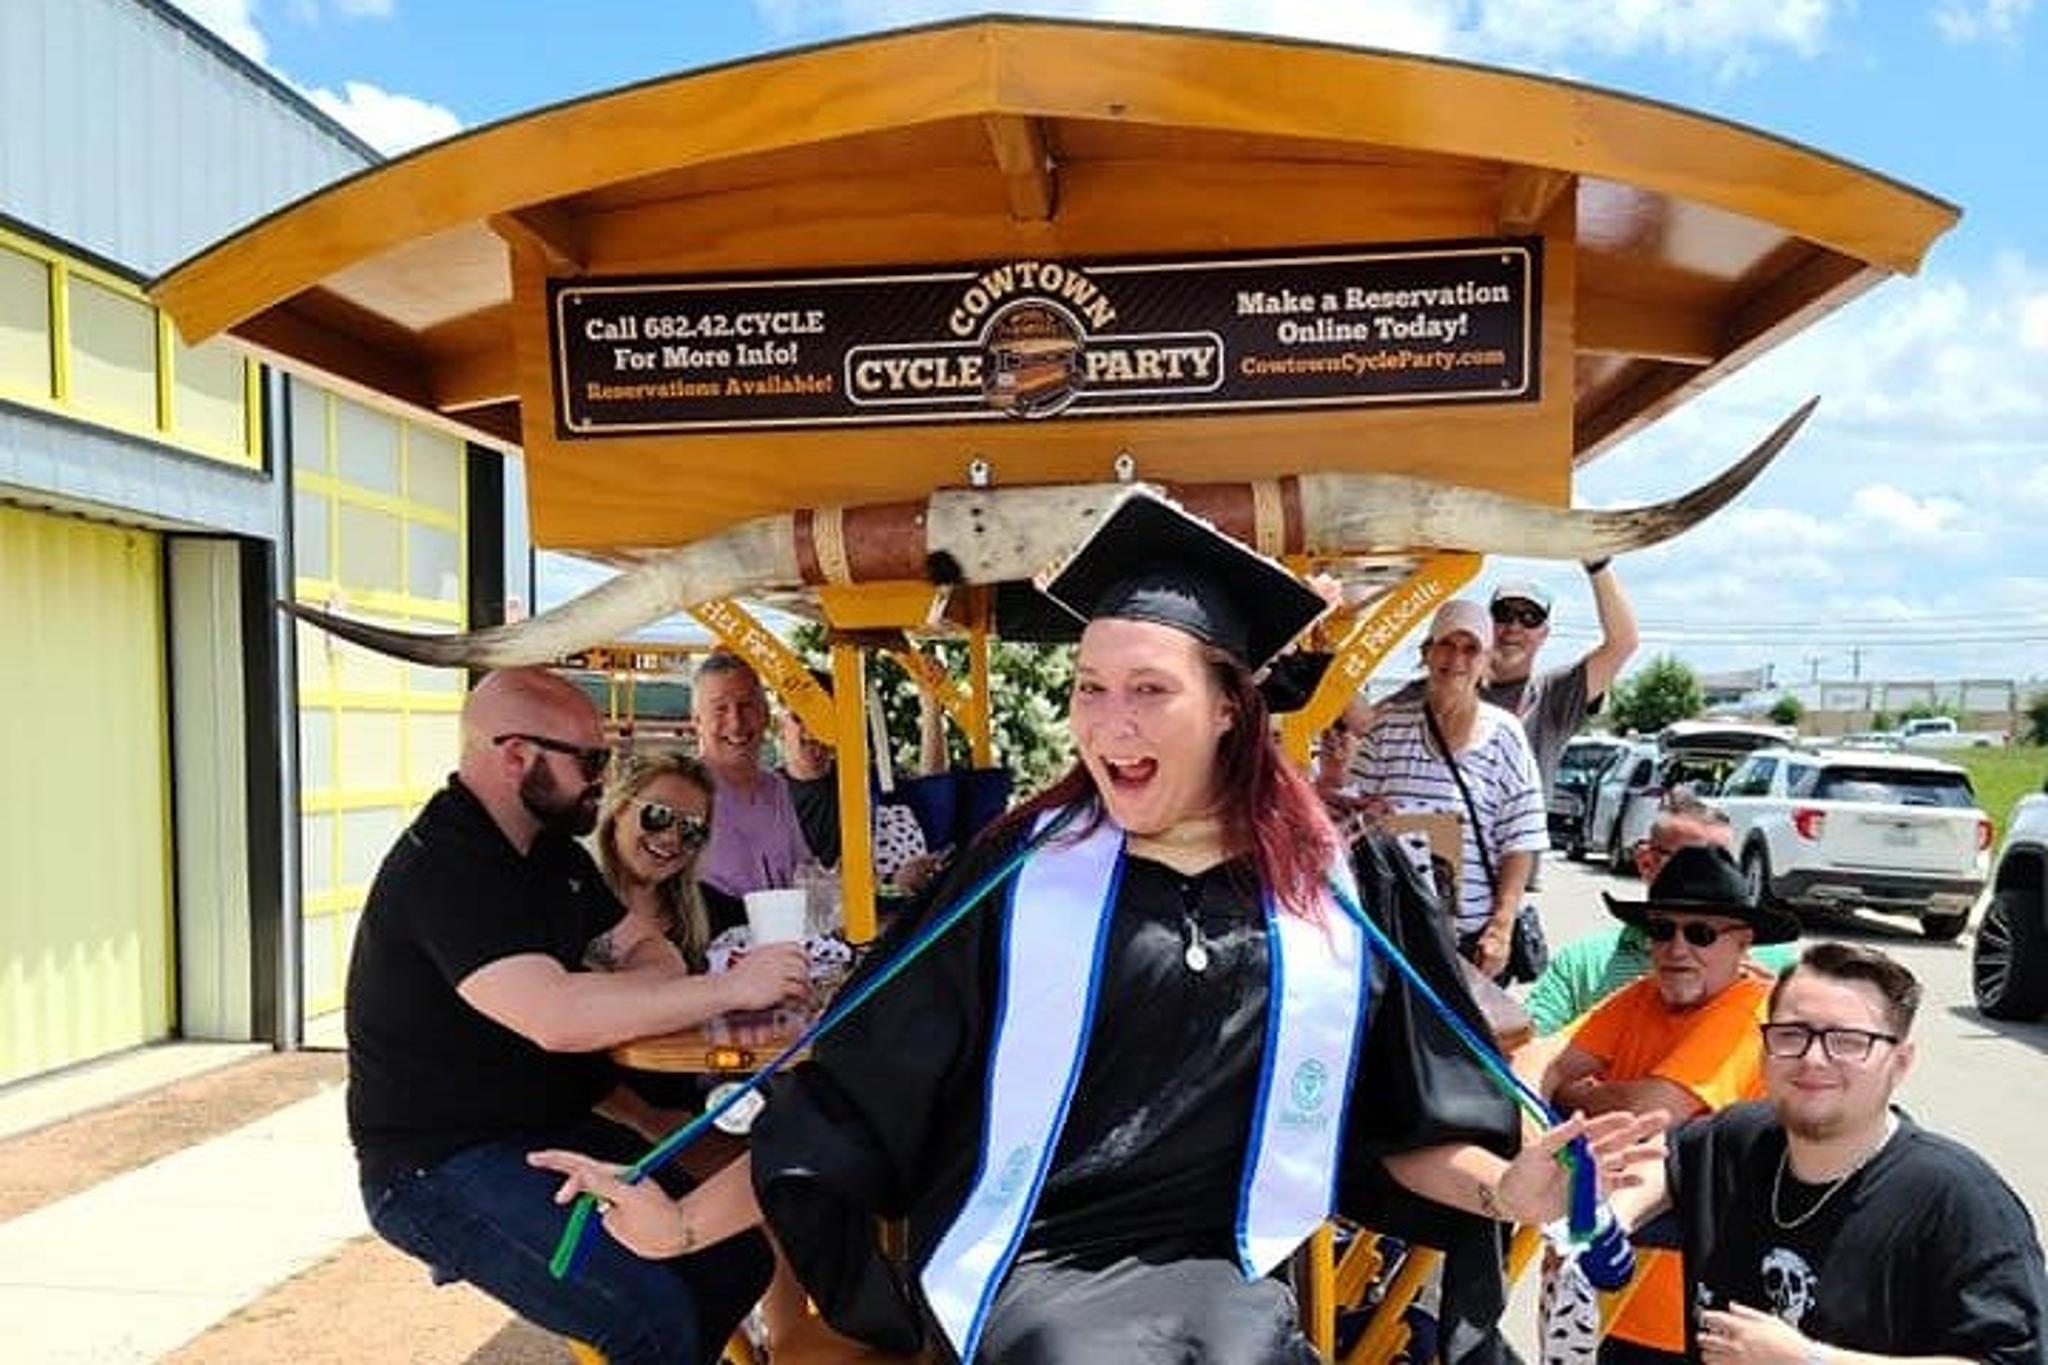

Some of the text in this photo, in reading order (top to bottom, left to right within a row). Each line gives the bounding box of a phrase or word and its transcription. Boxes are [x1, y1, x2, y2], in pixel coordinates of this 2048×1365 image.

[949, 262, 1116, 337] COWTOWN
[1236, 281, 1511, 315] Make a Reservation
[586, 311, 826, 341] Call 682.42.CYCLE
[1277, 313, 1469, 345] Online Today!
[613, 341, 799, 371] For More Info!
[855, 347, 1215, 391] CYCLE PARTY
[1241, 351, 1506, 377] CowtownCycleParty.com
[587, 374, 834, 401] Reservations Available!
